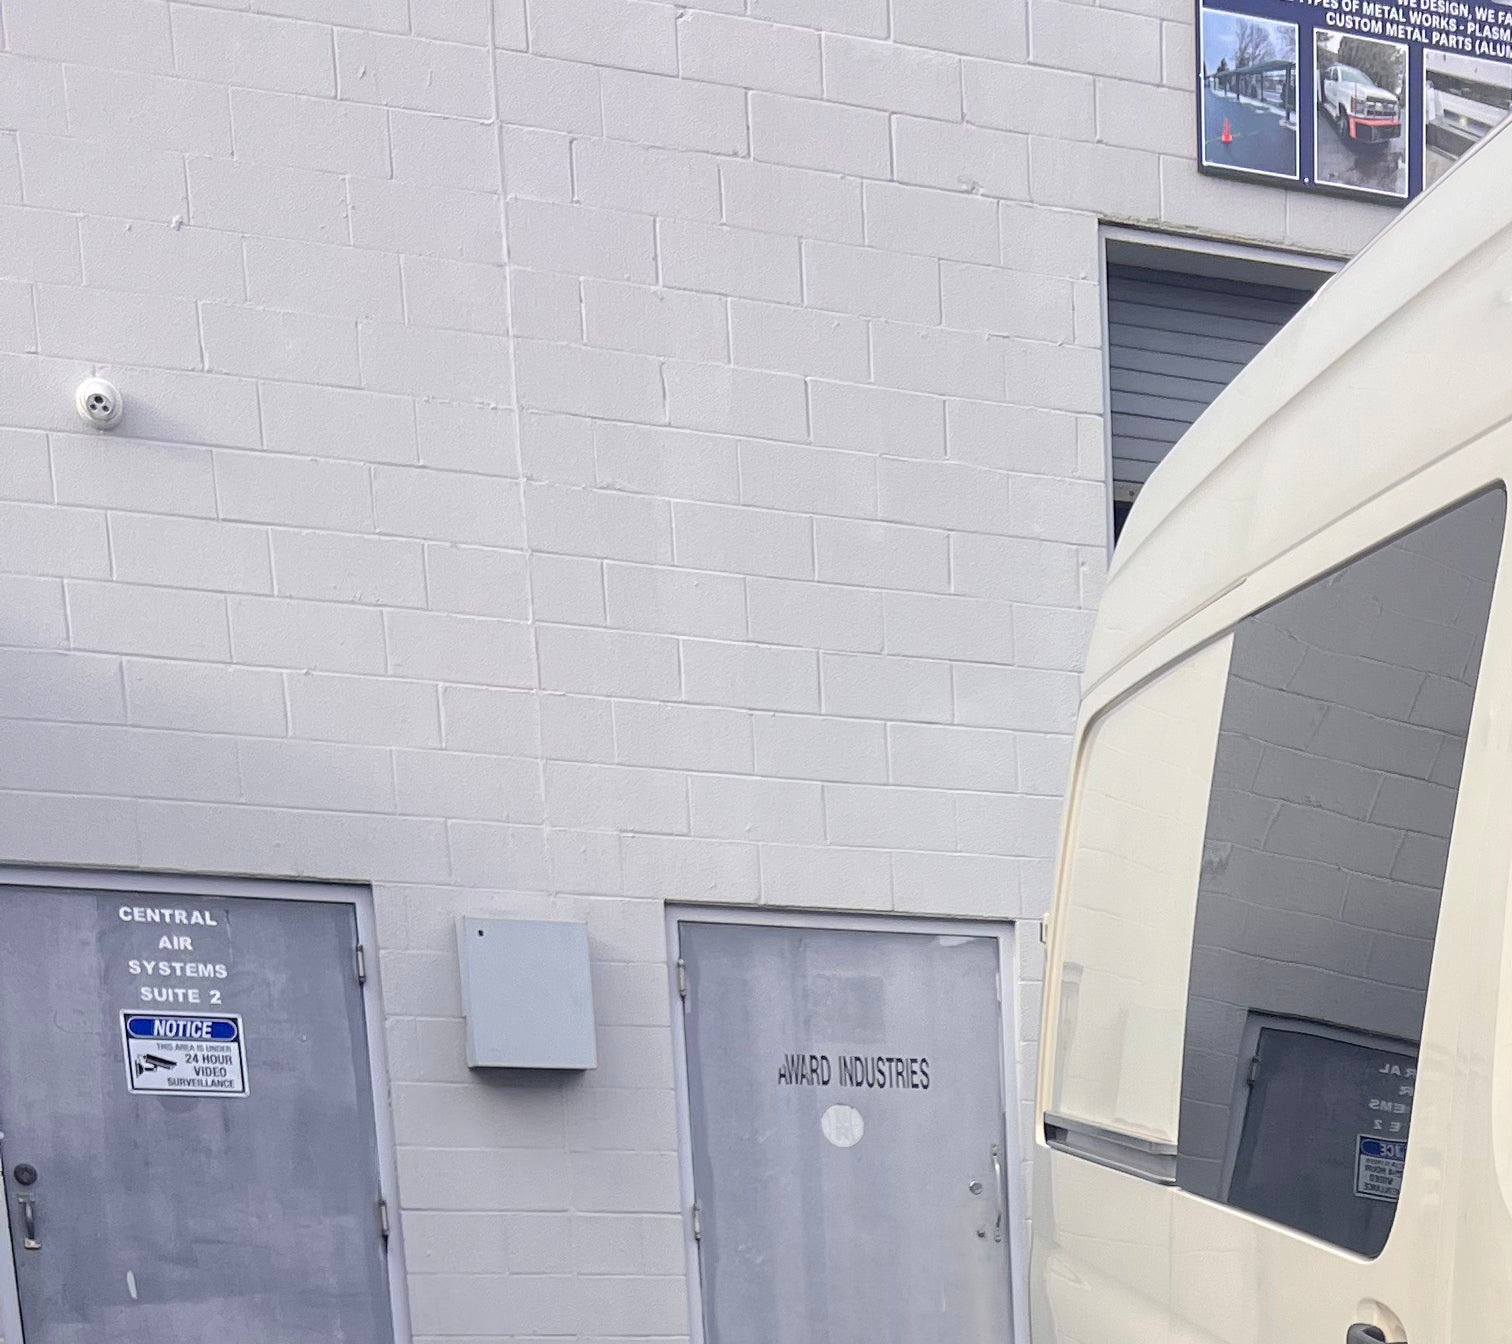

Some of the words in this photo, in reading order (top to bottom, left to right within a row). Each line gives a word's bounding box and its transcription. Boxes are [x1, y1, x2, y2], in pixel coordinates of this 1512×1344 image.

[1341, 0, 1359, 12] OF
[1362, 3, 1406, 22] METAL
[1409, 10, 1457, 31] WORKS
[1420, 0, 1472, 20] DESIGN,
[1475, 7, 1496, 23] WE
[1326, 12, 1382, 34] CUSTOM
[1386, 23, 1429, 43] METAL
[1432, 32, 1472, 51] PARTS
[119, 906, 218, 926] CENTRAL
[158, 935, 193, 951] AIR
[128, 960, 228, 979] SYSTEMS
[140, 986, 201, 1004] SUITE
[209, 989, 222, 1005] 2
[153, 1019, 213, 1039] NOTICE
[157, 1043, 173, 1051] THIS
[175, 1043, 194, 1052] AREA
[196, 1044, 204, 1052] IS
[185, 1054, 198, 1064] 24
[202, 1054, 233, 1066] HOUR
[194, 1066, 228, 1077] VIDEO
[778, 1054, 832, 1086] AWARD
[838, 1056, 930, 1090] INDUSTRIES
[167, 1078, 235, 1089] SURVEILLANCE
